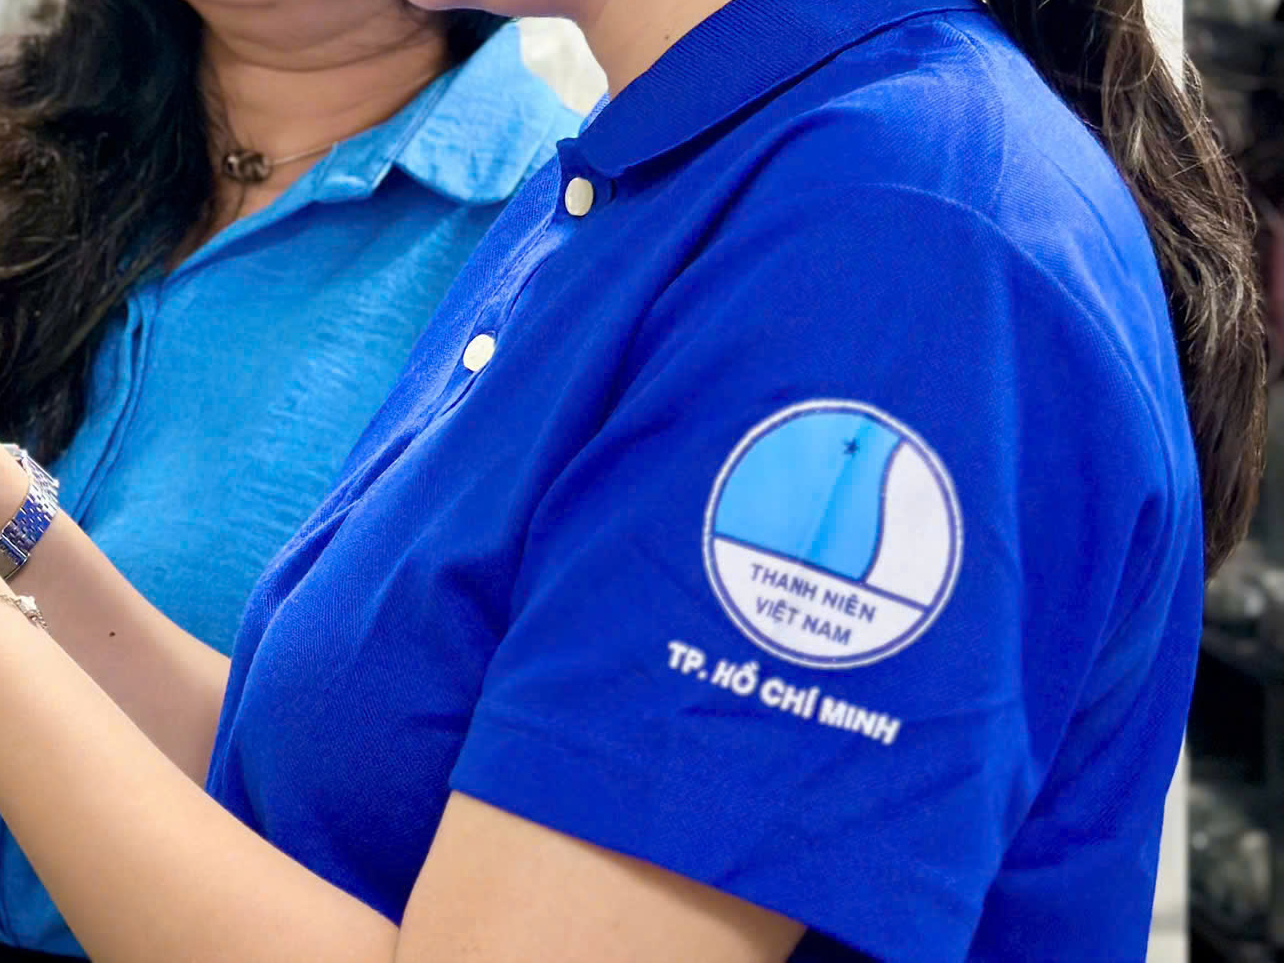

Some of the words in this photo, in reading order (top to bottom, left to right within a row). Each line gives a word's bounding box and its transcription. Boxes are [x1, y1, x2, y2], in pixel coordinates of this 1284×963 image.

[751, 563, 818, 601] THANH
[822, 588, 876, 623] NIÊN
[756, 596, 799, 626] VIỆT
[802, 614, 852, 646] NAM
[667, 640, 708, 681] TP.
[710, 657, 760, 697] HỒ
[759, 676, 820, 720] CHÍ
[819, 695, 902, 746] MINH
